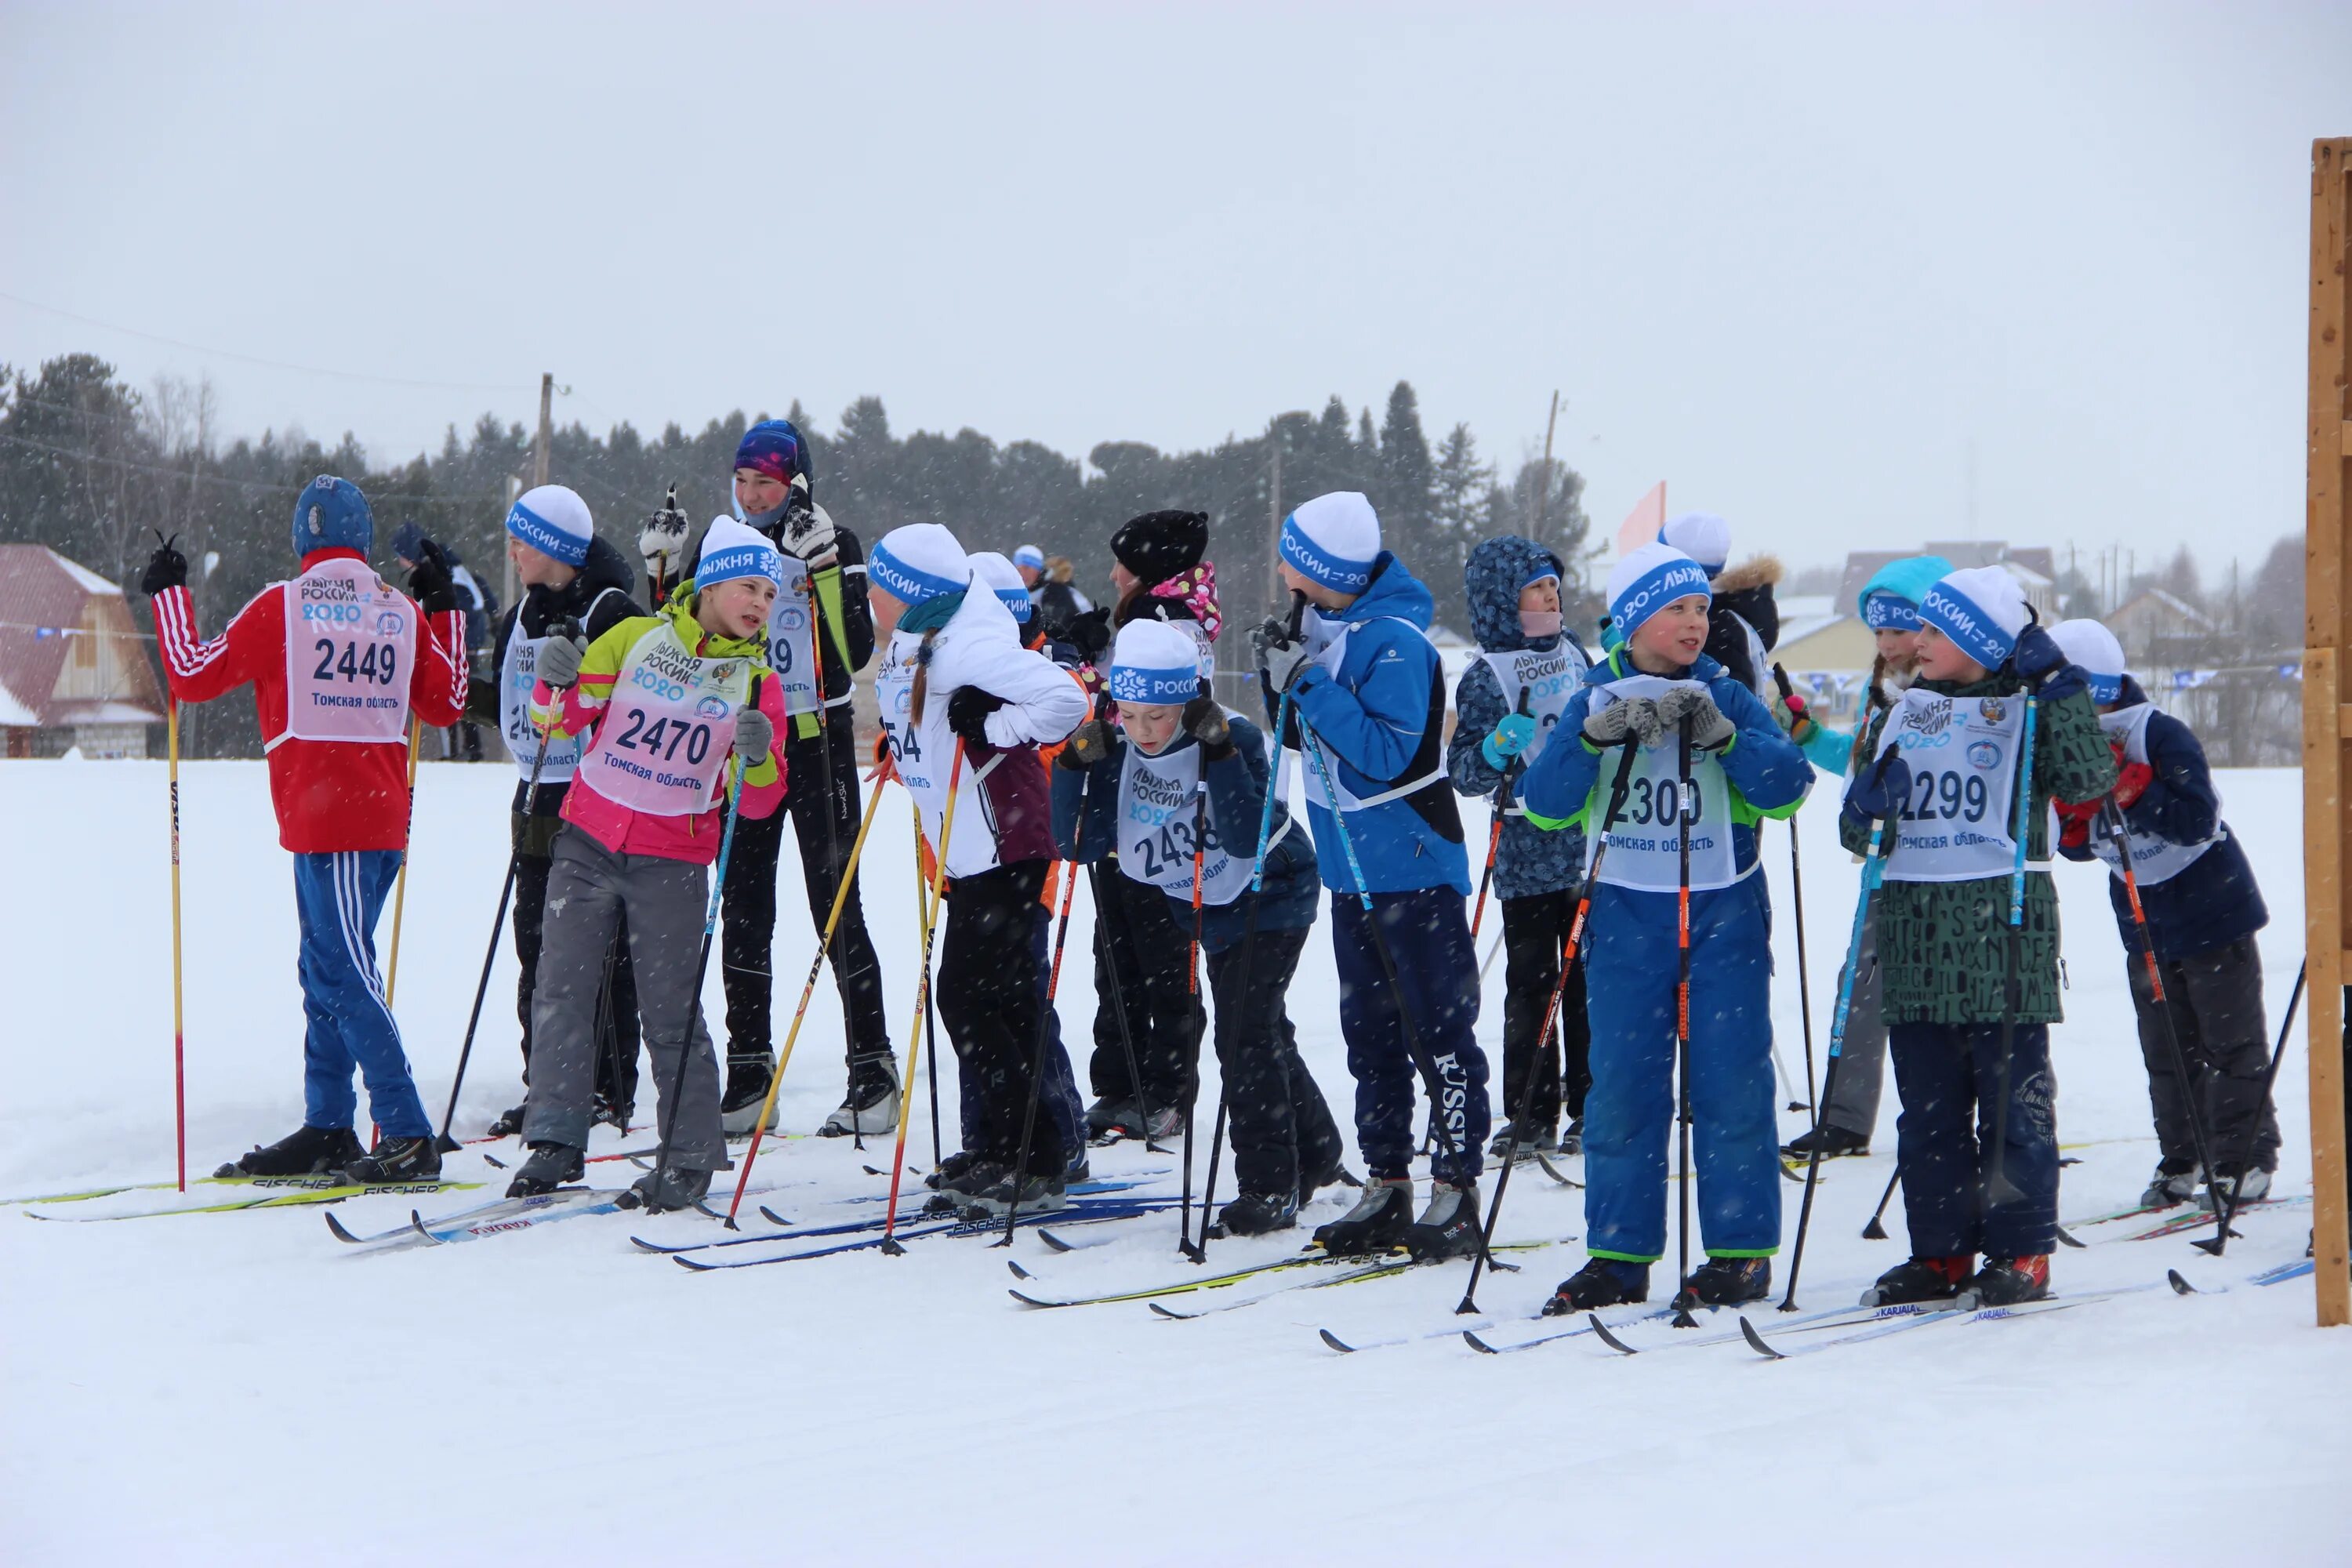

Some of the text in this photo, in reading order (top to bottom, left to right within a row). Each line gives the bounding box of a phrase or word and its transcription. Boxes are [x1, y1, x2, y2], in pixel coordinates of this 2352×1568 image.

[511, 512, 588, 559] РОССИИ 20
[1282, 528, 1368, 586] РОССИИ 20
[871, 555, 921, 597] РОССИИ
[1664, 568, 1708, 591] ЛЫЖ
[301, 588, 359, 603] РОССИИ
[302, 604, 362, 622] 2020
[1922, 590, 1976, 636] РОССИИ
[1982, 639, 2007, 659] 20
[313, 638, 396, 685] 2449
[642, 652, 693, 684] РОССИИ
[652, 641, 703, 671] ЛЫЖНЯ
[1516, 658, 1568, 683] РОССИИ
[631, 666, 684, 701] 2020
[1154, 680, 1198, 695] РОССИ
[311, 692, 362, 708] Томская
[510, 704, 543, 732] 24
[616, 709, 710, 765] 2470
[884, 722, 922, 763] 54
[604, 752, 702, 790] Томская область
[1132, 782, 1185, 807] РОССИИ
[1611, 777, 1702, 827] 2300
[1134, 815, 1221, 878] 2438
[1608, 833, 1714, 852] омская обасть
[1896, 833, 1948, 849] Томская
[252, 1179, 329, 1189] FISCHE
[1880, 1304, 1917, 1317] KARJALA
